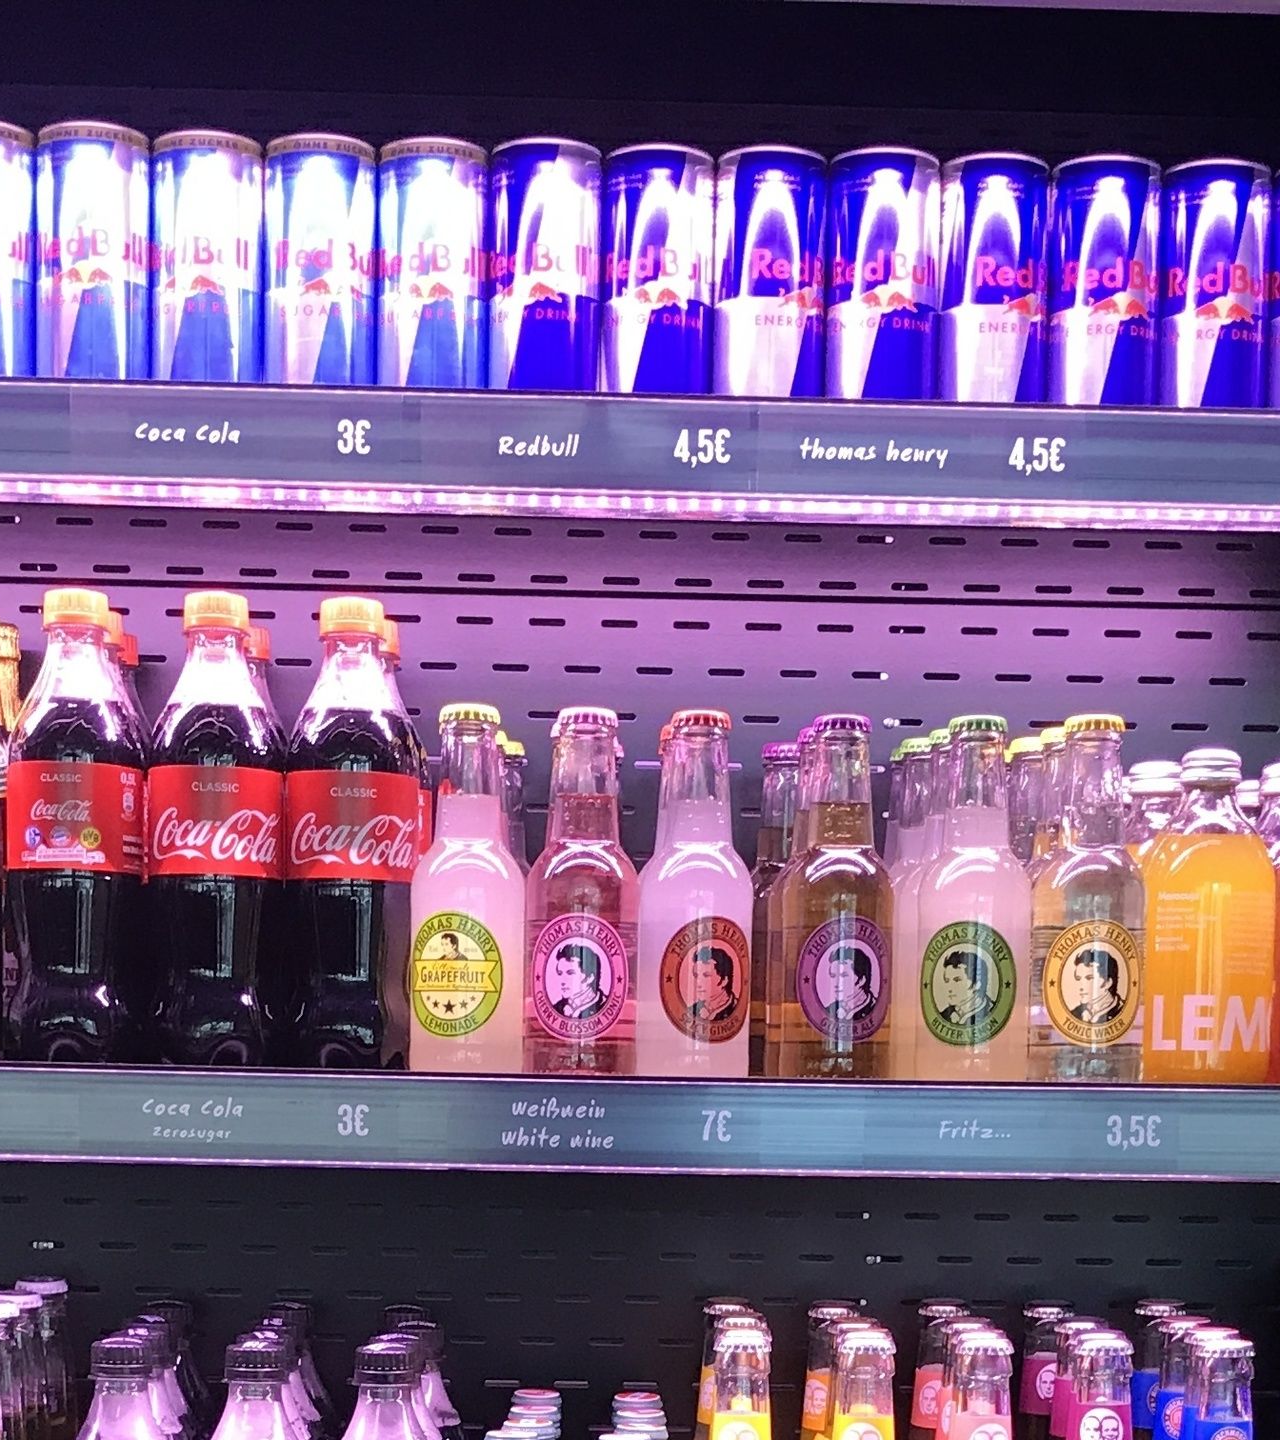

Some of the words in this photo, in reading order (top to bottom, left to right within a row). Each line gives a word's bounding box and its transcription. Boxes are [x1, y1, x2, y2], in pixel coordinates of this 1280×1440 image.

[751, 247, 809, 282] Red
[974, 256, 1034, 290] Red
[135, 423, 186, 443] Coca
[195, 425, 241, 445] Cola
[336, 419, 372, 455] 3€
[498, 434, 580, 458] Redbull
[673, 429, 732, 468] 4,5€
[800, 437, 878, 463] thomas
[887, 440, 950, 470] henry
[1008, 437, 1067, 475] 4,5€
[40, 773, 82, 783] CLASSIC
[191, 781, 240, 794] CLASSIC
[330, 786, 378, 799] CLASSIC
[30, 799, 93, 823] Coca-Cola
[153, 805, 279, 864] Coca-Cola
[290, 811, 416, 870] Coca-Cola
[416, 917, 453, 952] THOMAS
[457, 919, 496, 954] HENRY
[537, 921, 582, 957] THOMAS
[585, 923, 621, 959] HENRY
[927, 928, 969, 964] THOMAS
[972, 928, 1009, 964] HENRY
[1052, 926, 1101, 961] THOMAS
[1104, 928, 1137, 962] HENRY
[421, 966, 485, 983] GRAPEFRUIT
[424, 1015, 477, 1032] LEMONADE
[559, 1018, 602, 1035] BLOSSOM
[932, 1017, 964, 1039] BITTER
[1062, 1017, 1092, 1038] TONIC
[1094, 1018, 1126, 1038] WATER
[142, 1098, 190, 1117] Coca
[201, 1097, 244, 1118] Cola
[338, 1104, 369, 1136] 3€
[570, 1129, 614, 1149] wine
[702, 1110, 732, 1142] 7€
[1106, 1115, 1162, 1152] 3,5€
